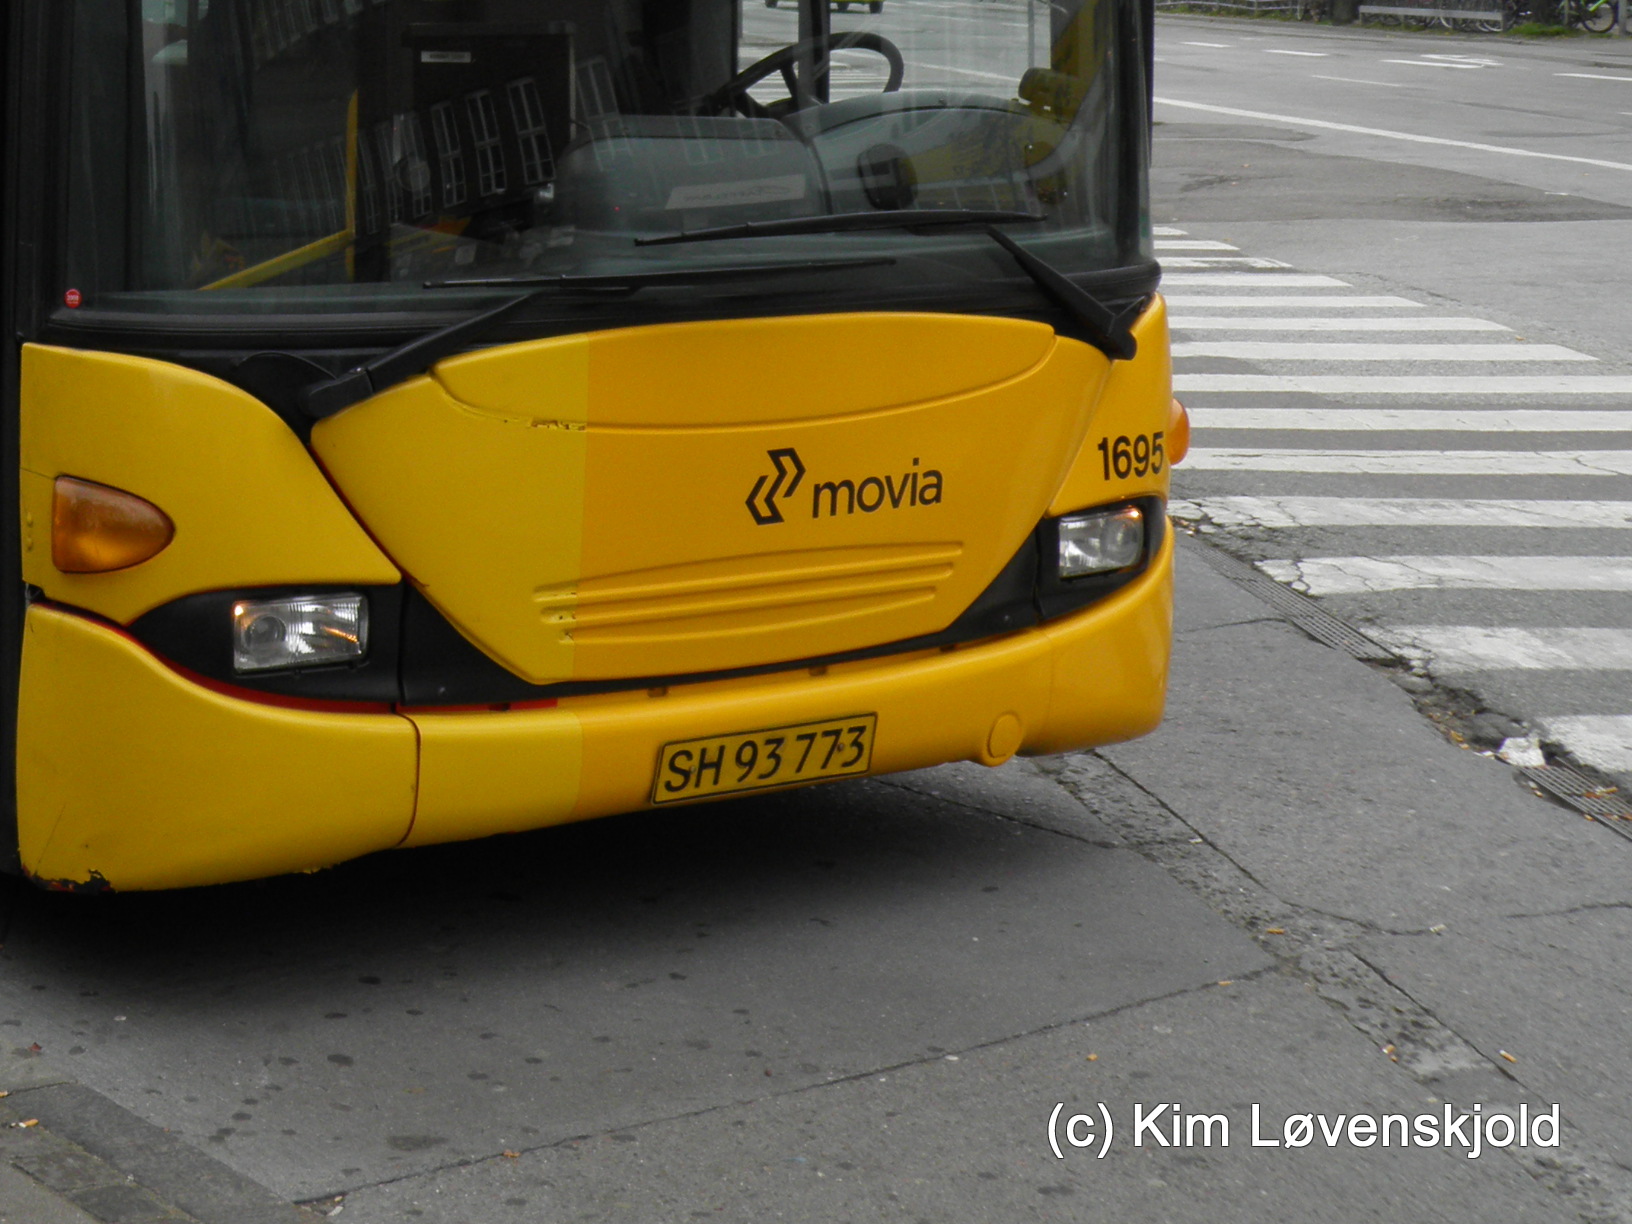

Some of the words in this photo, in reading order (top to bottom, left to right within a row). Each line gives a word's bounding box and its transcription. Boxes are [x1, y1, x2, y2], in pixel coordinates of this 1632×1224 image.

[1097, 431, 1165, 482] 1695
[811, 457, 944, 519] movia
[664, 745, 727, 793] SH
[734, 737, 784, 783] 93
[794, 725, 868, 776] 773
